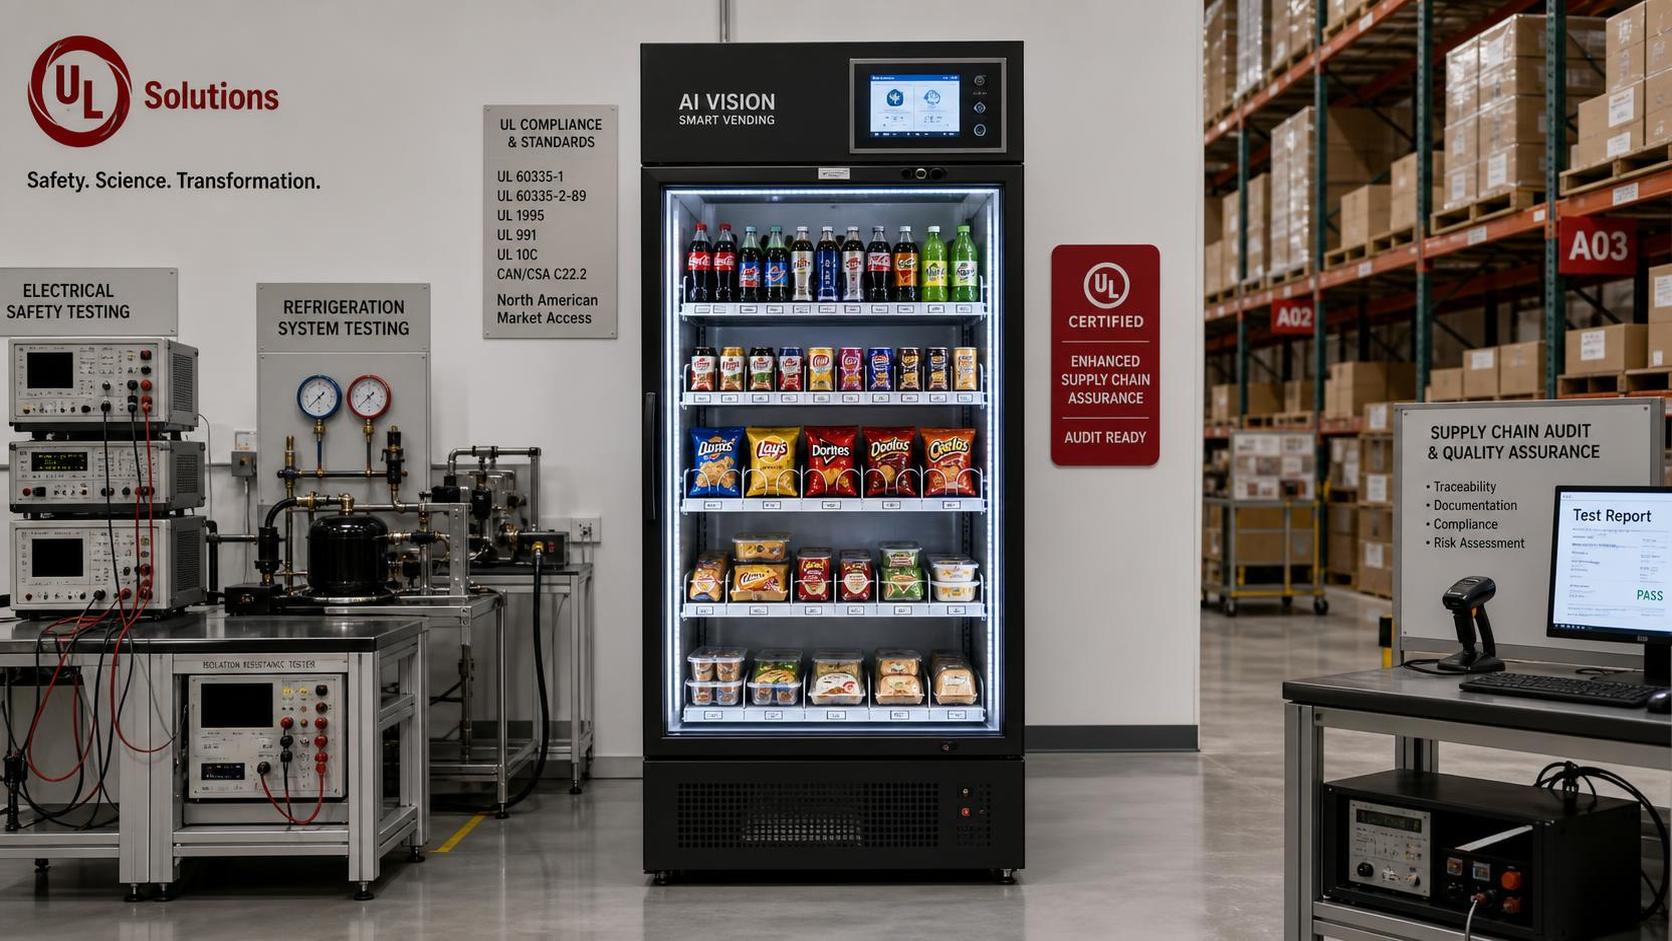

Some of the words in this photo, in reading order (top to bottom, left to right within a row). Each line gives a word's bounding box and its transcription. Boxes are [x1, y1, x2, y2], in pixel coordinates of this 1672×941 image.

[55, 64, 104, 119] UL
[145, 81, 278, 110] Solutions
[679, 94, 698, 110] AI
[707, 93, 774, 110] VISION
[501, 119, 516, 130] UL
[521, 119, 601, 130] COMPLIANCE
[680, 115, 719, 125] SMART
[723, 115, 774, 124] VENDING
[508, 136, 516, 148] &
[521, 136, 594, 147] STANDARDS
[28, 171, 89, 192] Safety.
[96, 172, 171, 188] Science.
[177, 172, 320, 189] Transformation.
[498, 171, 512, 182] UL
[516, 170, 562, 182] 60335-1
[498, 190, 512, 201] UL
[516, 190, 586, 201] 60335-2-89
[498, 210, 512, 221] UL
[517, 210, 544, 221] 1995
[498, 229, 513, 240] UL
[516, 229, 535, 240] 991
[1569, 231, 1626, 260] A03
[498, 249, 512, 260] UL
[517, 249, 537, 260] 10C
[497, 268, 550, 280] CAN/CSA
[554, 268, 586, 280] C22.2
[24, 284, 114, 297] ELECTRICAL
[1094, 273, 1119, 299] UL
[498, 294, 533, 306] North
[538, 294, 597, 306] American
[7, 305, 62, 318] SAFETY
[67, 305, 129, 318] TESTING
[284, 300, 404, 314] REFRIGERATION
[498, 312, 542, 323] Market
[547, 312, 591, 324] Access
[1069, 316, 1143, 327] CERTIFIED
[1278, 308, 1310, 326] A02
[279, 321, 338, 335] SYSTEM
[344, 321, 409, 335] TESTING
[1072, 355, 1140, 367] ENHANCED
[1062, 374, 1108, 385] SUPPLY
[1112, 374, 1150, 385] CHAIN
[1068, 392, 1143, 404] ASSURANCE
[1065, 432, 1102, 443] AUDIT
[1106, 432, 1146, 443] READY
[1431, 425, 1486, 439] SUPPLY
[1492, 424, 1538, 438] CHAIN
[1544, 424, 1591, 438] AUDIT
[758, 439, 788, 457] Lay's
[1428, 446, 1438, 459] &
[1443, 446, 1504, 461] QUALITY
[1509, 445, 1600, 459] ASSURANCE
[1435, 481, 1496, 494] Traceability
[1435, 500, 1517, 510] Documentation
[1573, 509, 1601, 521] Test
[1606, 509, 1651, 524] Report
[1434, 518, 1498, 531] Compliance
[1435, 537, 1455, 548] Risk
[1460, 537, 1524, 548] Assessment
[1637, 590, 1663, 600] PASS
